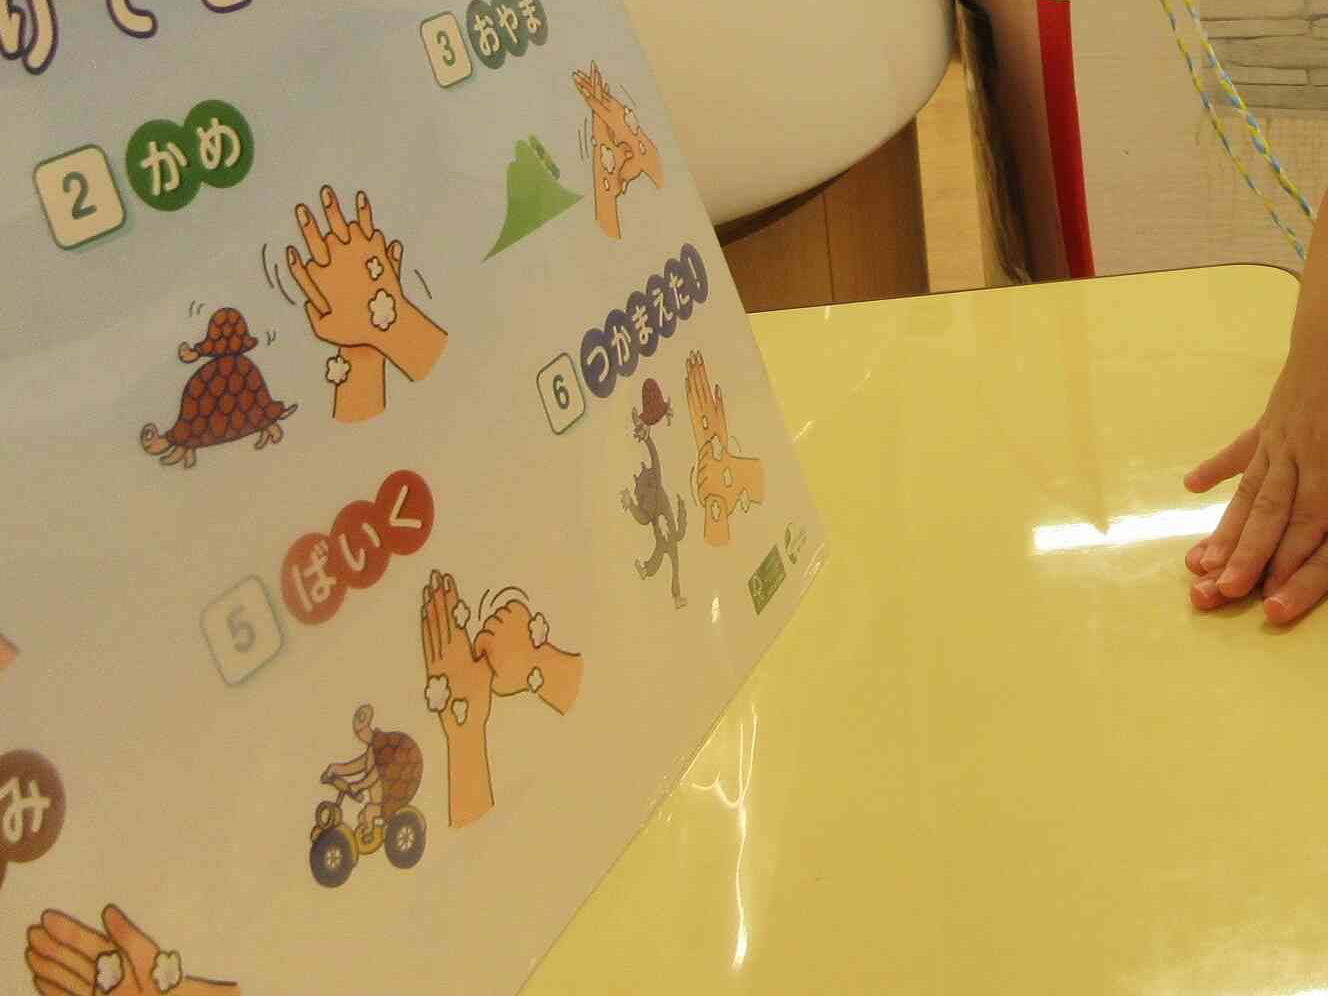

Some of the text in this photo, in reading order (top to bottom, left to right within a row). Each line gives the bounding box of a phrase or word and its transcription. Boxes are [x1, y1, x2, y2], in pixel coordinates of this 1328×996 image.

[436, 30, 456, 67] 3
[62, 116, 242, 220] 2 かめ
[552, 256, 702, 410] 6 つかまえた!
[226, 484, 423, 654] 5 ばいく
